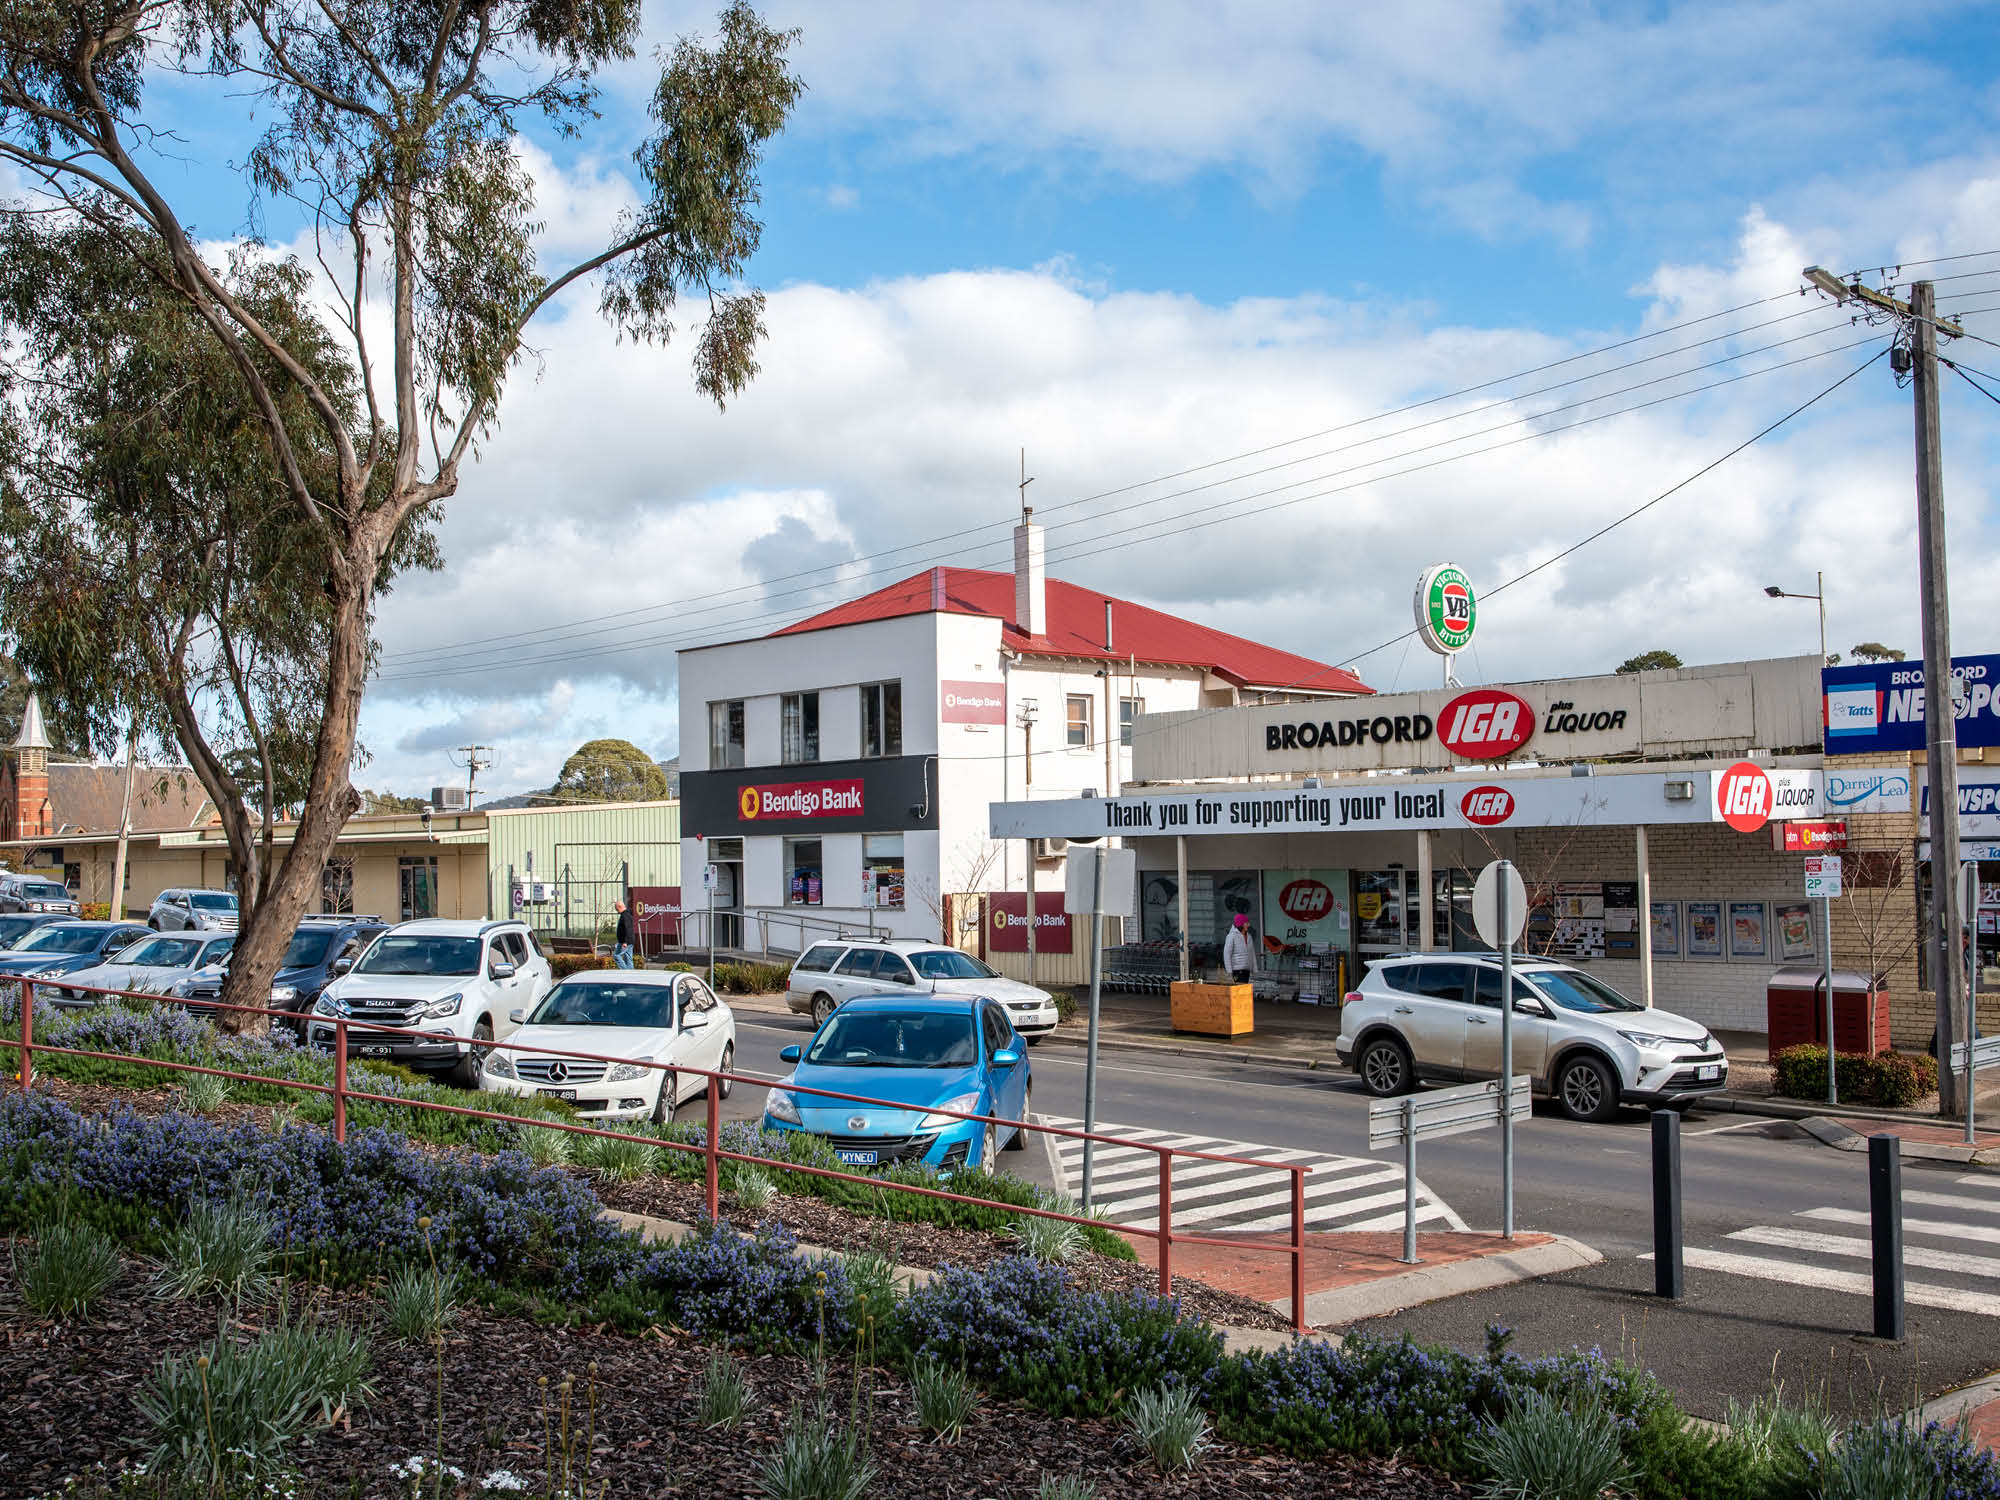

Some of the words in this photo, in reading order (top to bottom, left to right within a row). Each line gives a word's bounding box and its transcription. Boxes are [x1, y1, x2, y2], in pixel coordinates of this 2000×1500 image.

[1435, 571, 1472, 593] VICTORIA
[1444, 596, 1469, 618] VB
[1438, 628, 1471, 645] BITTER
[1892, 666, 1987, 684] BROORD
[1550, 701, 1574, 712] plus
[1848, 705, 1874, 716] Tatts
[1266, 714, 1433, 750] BROADFORD
[1447, 701, 1520, 743] IGA
[1544, 709, 1627, 734] LIQUOR
[1778, 777, 1791, 786] plus
[1829, 776, 1877, 798] Darrell
[1878, 776, 1904, 797] Lea
[763, 789, 820, 816] Bendigo
[822, 786, 861, 810] Bank
[1466, 792, 1508, 816] IGA
[1724, 776, 1767, 815] IGA
[1776, 788, 1815, 806] LIQUOR
[1105, 801, 1153, 827] Thank
[1159, 803, 1188, 830] you
[1195, 798, 1223, 825] for
[1230, 794, 1331, 828] supporting
[1339, 796, 1387, 825] your
[1394, 789, 1445, 819] local
[1807, 879, 1822, 889] 2P
[1285, 888, 1327, 911] IGA
[1043, 914, 1066, 926] Bank
[1286, 926, 1307, 939] plus
[842, 1152, 874, 1163] MYNEO
